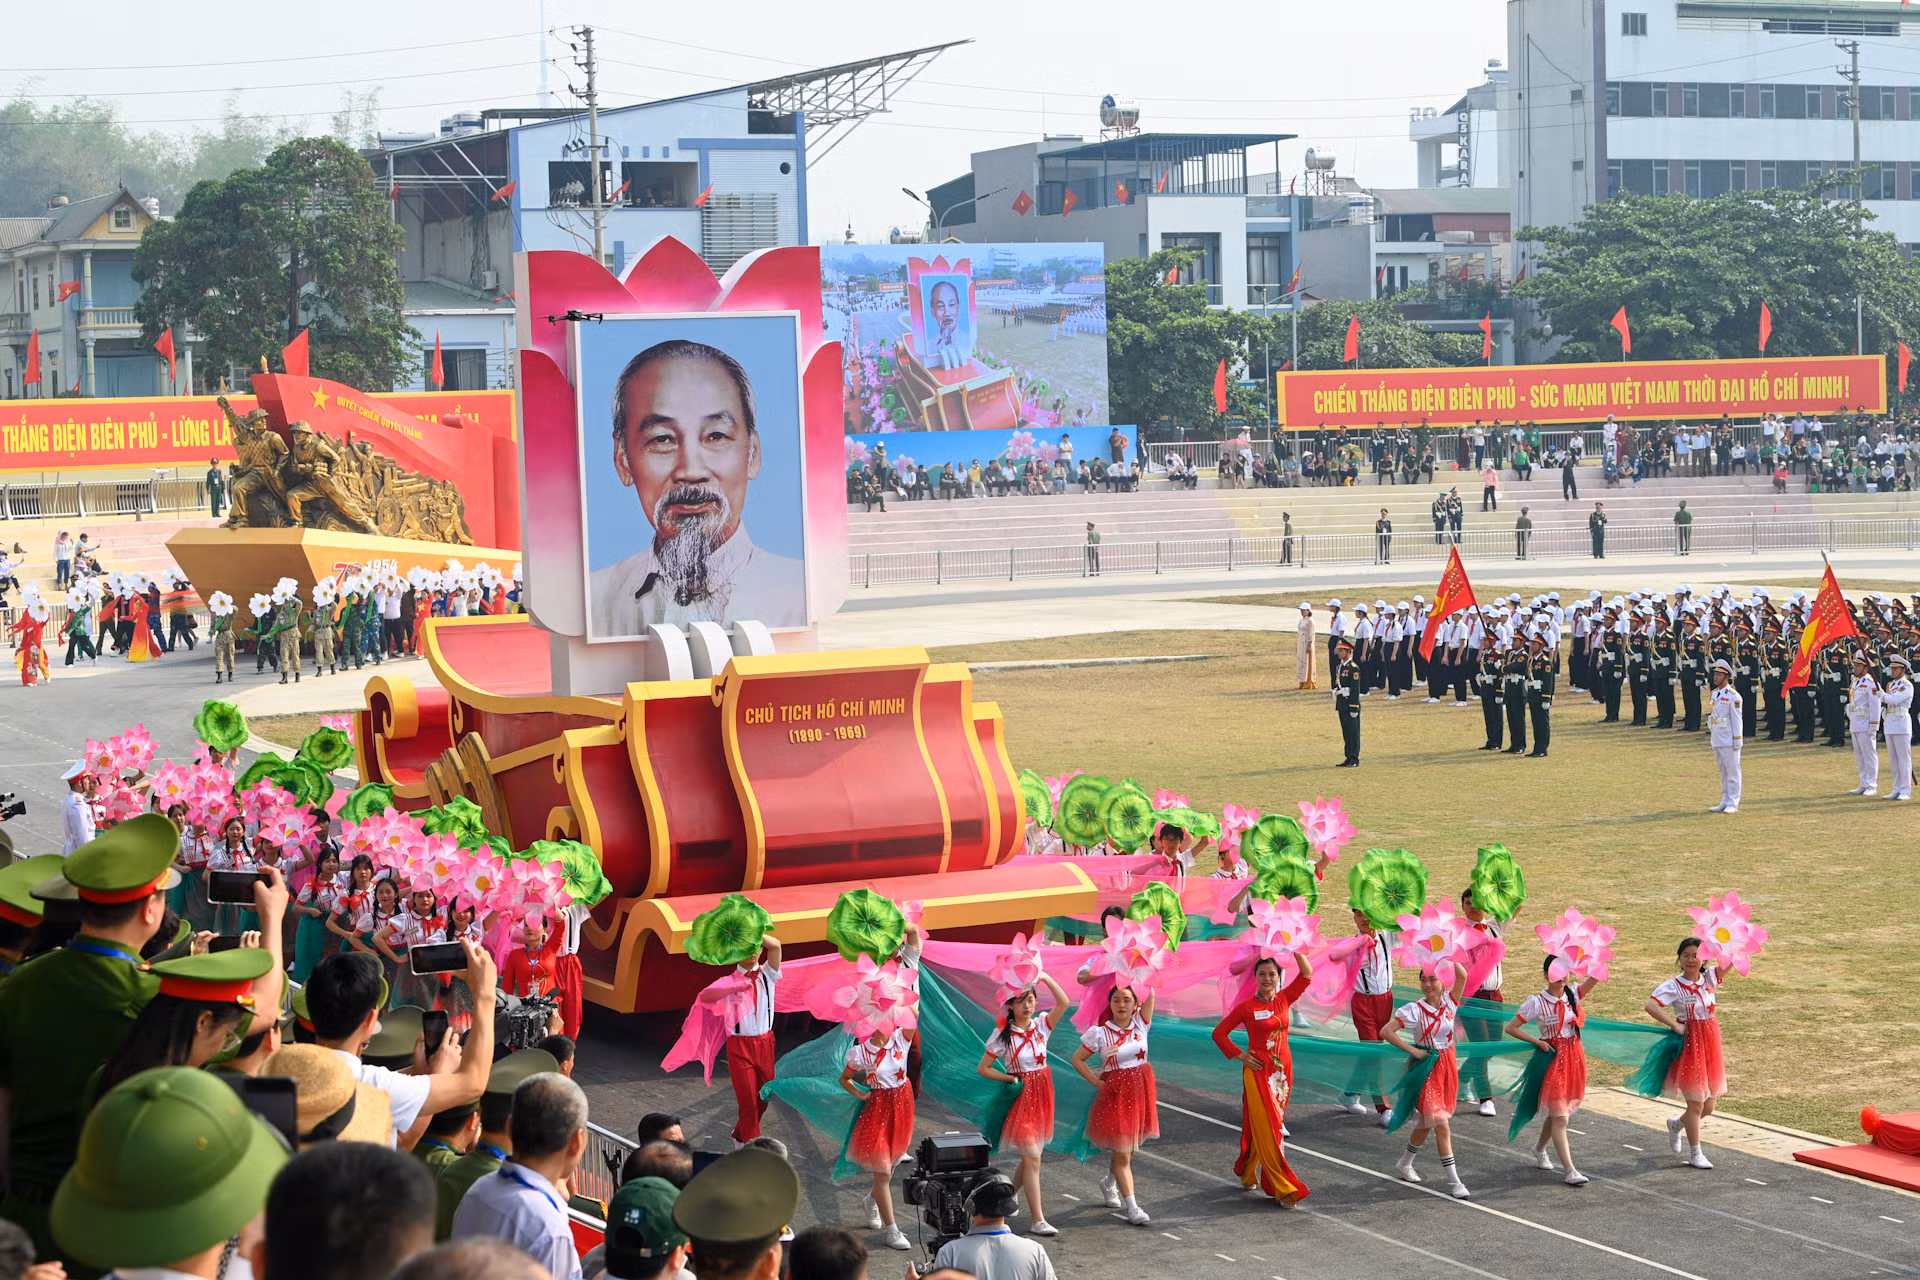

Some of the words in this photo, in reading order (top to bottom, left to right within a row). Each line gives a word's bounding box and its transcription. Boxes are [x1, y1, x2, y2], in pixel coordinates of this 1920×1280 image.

[1459, 136, 1469, 188] KARA
[1314, 383, 1356, 413] CHIẾN
[1360, 380, 1407, 412] THẮNG
[1411, 384, 1445, 416] ĐIỆN
[1449, 382, 1482, 411] BIÊN
[1487, 378, 1516, 409] PHỦ
[1530, 380, 1559, 408] SỨC
[1563, 382, 1607, 411] MẠNH
[1611, 377, 1641, 410] VIỆT
[1645, 380, 1680, 404] NAM
[1683, 373, 1716, 403] THỜI
[1720, 378, 1745, 407] ĐẠI
[1749, 370, 1769, 401] HỒ
[1774, 372, 1798, 400] CHÍ
[2, 414, 49, 453] THẮNG
[53, 418, 88, 457] ĐIỆN
[91, 417, 125, 450] BIÊN
[128, 412, 158, 449] PHỦ
[172, 415, 210, 447] LỪNG
[336, 395, 358, 412] QUYẾT
[358, 405, 381, 423] CHIẾN
[381, 417, 402, 433] QUYẾT
[402, 424, 423, 440] THẮNG
[745, 702, 774, 724] CHỦ
[780, 705, 812, 724] TỊCH
[816, 698, 836, 720] HỒ
[841, 698, 864, 717] CHÍ
[868, 698, 905, 716] MINH
[789, 728, 823, 744] (1890
[833, 724, 867, 740] 1969)
